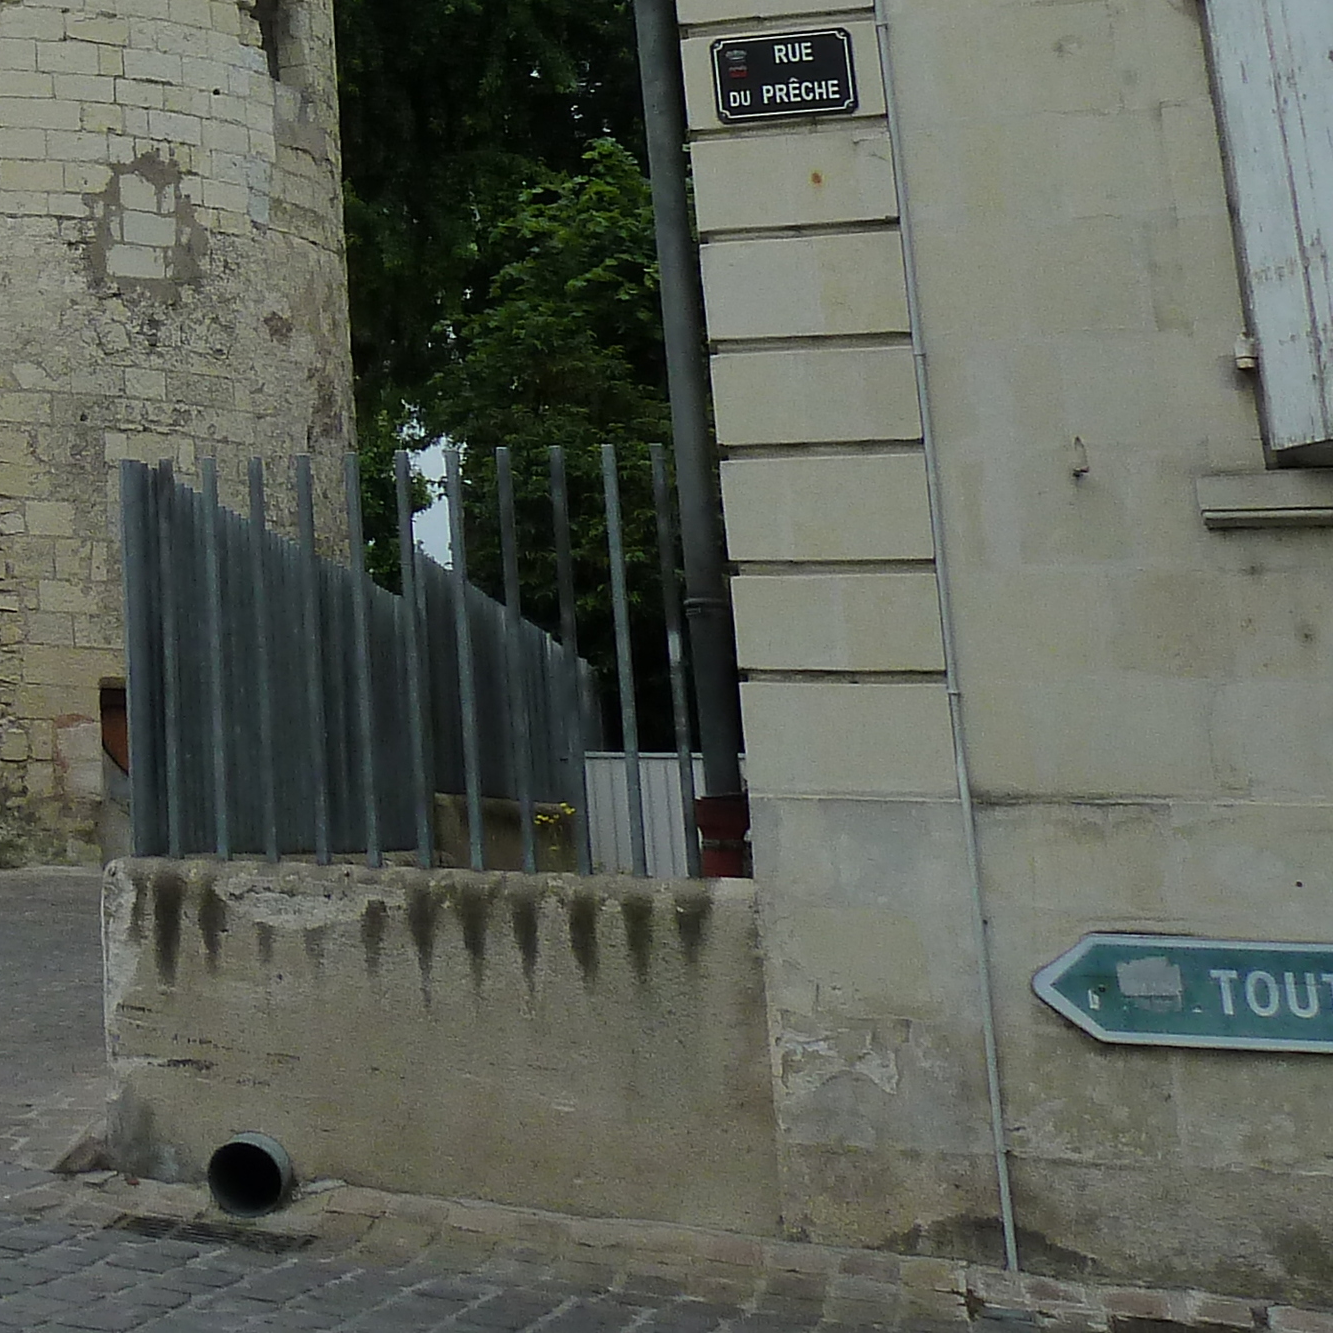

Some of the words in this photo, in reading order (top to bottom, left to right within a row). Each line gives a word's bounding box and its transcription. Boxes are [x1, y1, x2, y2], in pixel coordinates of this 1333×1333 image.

[773, 42, 814, 64] RUE
[729, 90, 751, 107] DU
[762, 77, 841, 105] PRÊCHE
